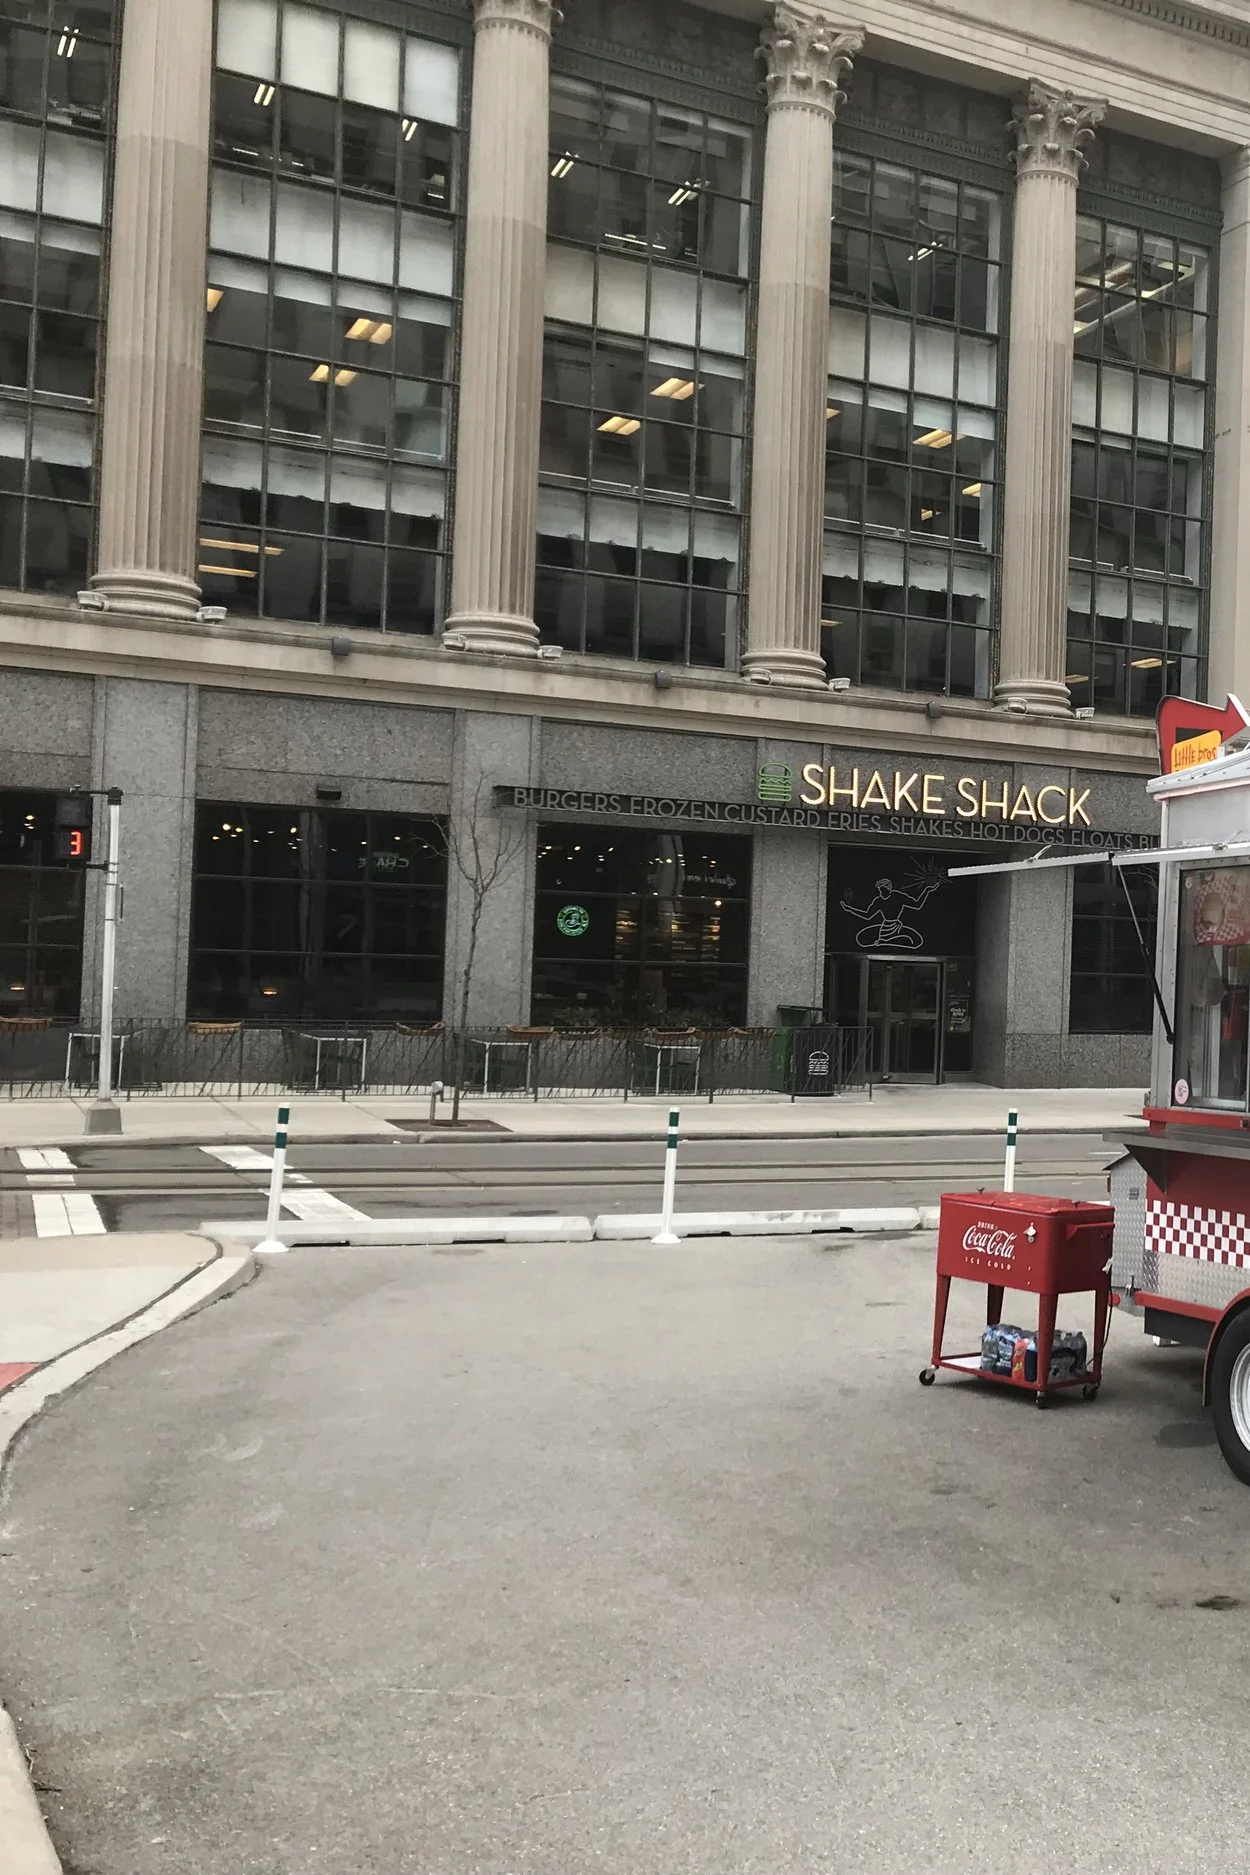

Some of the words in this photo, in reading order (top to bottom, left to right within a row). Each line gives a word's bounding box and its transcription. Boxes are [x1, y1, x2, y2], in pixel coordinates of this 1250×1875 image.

[800, 763, 946, 815] SHAKE
[956, 777, 1091, 826] SHACK
[513, 787, 621, 813] BURGERS
[630, 796, 719, 820] FROZEN
[724, 804, 821, 827] CUSTARD
[827, 811, 881, 832] FRIES
[889, 816, 963, 837] SHAKES
[970, 821, 1009, 840] HOT
[1013, 826, 1065, 845] DOGS
[1071, 830, 1133, 849] FLOATS
[70, 831, 81, 855] 3
[965, 1256, 980, 1265] ICE
[987, 1260, 1011, 1271] COLD
